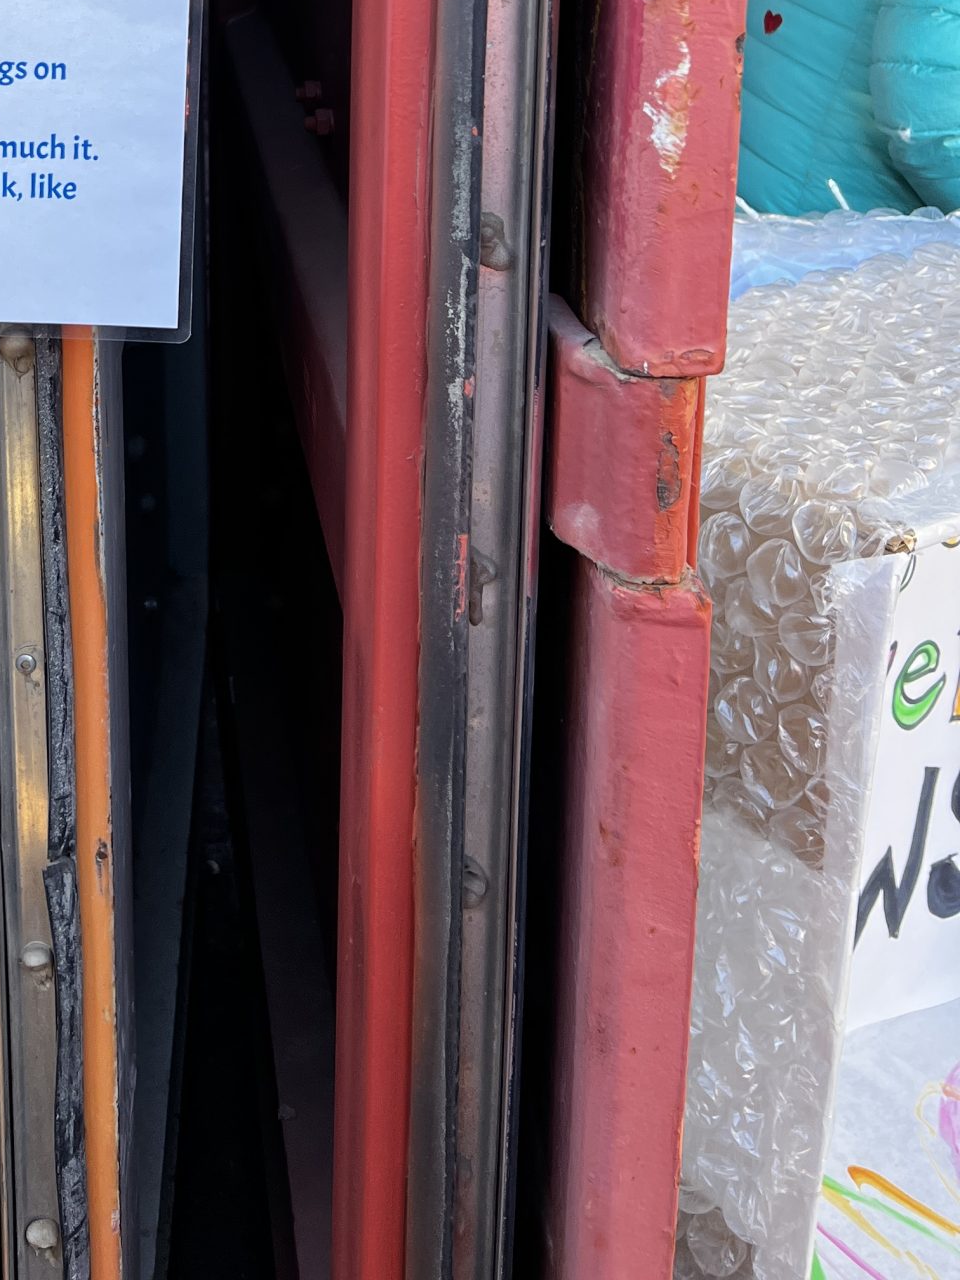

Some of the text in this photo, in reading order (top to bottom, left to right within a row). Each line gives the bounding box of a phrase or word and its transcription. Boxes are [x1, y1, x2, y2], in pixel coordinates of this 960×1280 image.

[33, 61, 67, 81] on
[73, 134, 100, 161] it.
[30, 172, 77, 201] like
